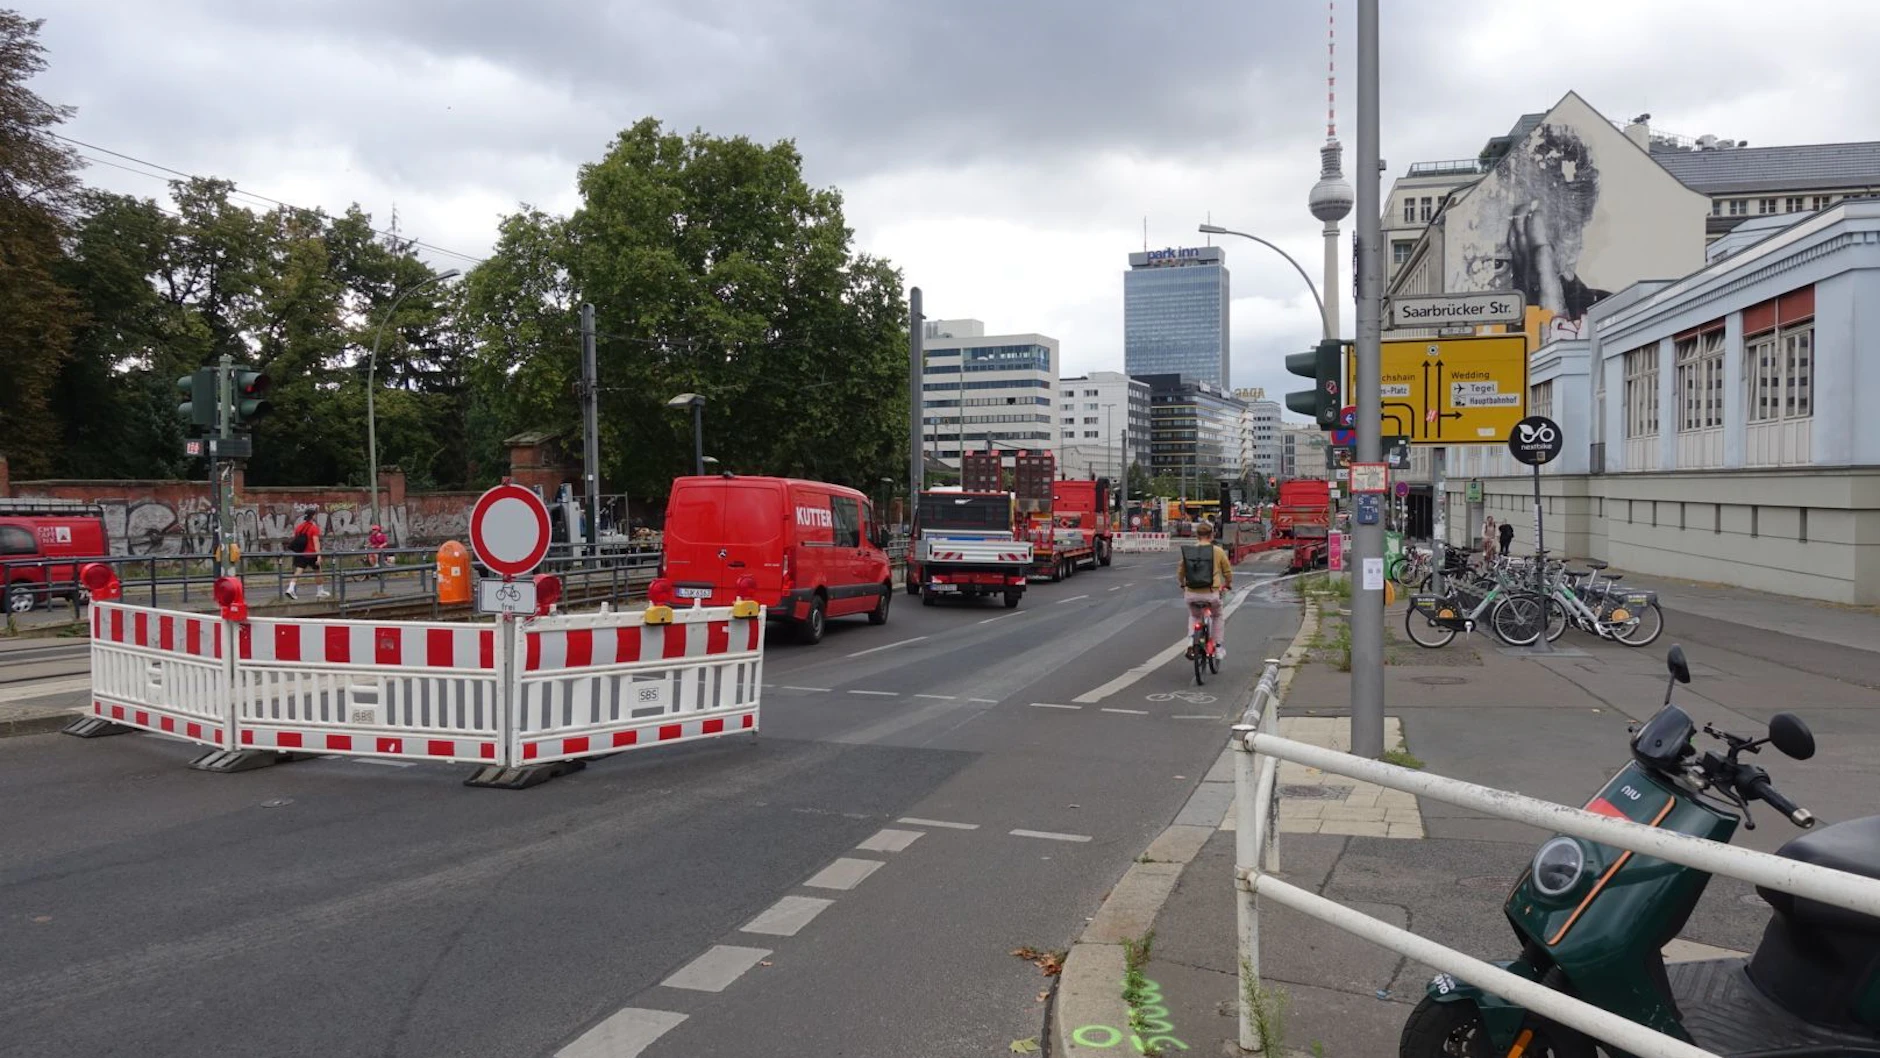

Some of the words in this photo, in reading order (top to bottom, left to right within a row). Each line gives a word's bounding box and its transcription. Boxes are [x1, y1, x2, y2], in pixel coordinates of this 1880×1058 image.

[1148, 247, 1176, 260] park
[1178, 246, 1199, 257] inn
[1402, 303, 1485, 318] Saarbrücker
[1490, 301, 1511, 314] Str.
[1451, 371, 1490, 381] Wedding
[1470, 384, 1495, 394] Tegel
[1469, 395, 1517, 406] Hauptbahnhof
[1520, 443, 1553, 451] nextbike
[795, 506, 832, 527] KUTTER
[501, 603, 516, 611] frei
[640, 689, 657, 701] SBS
